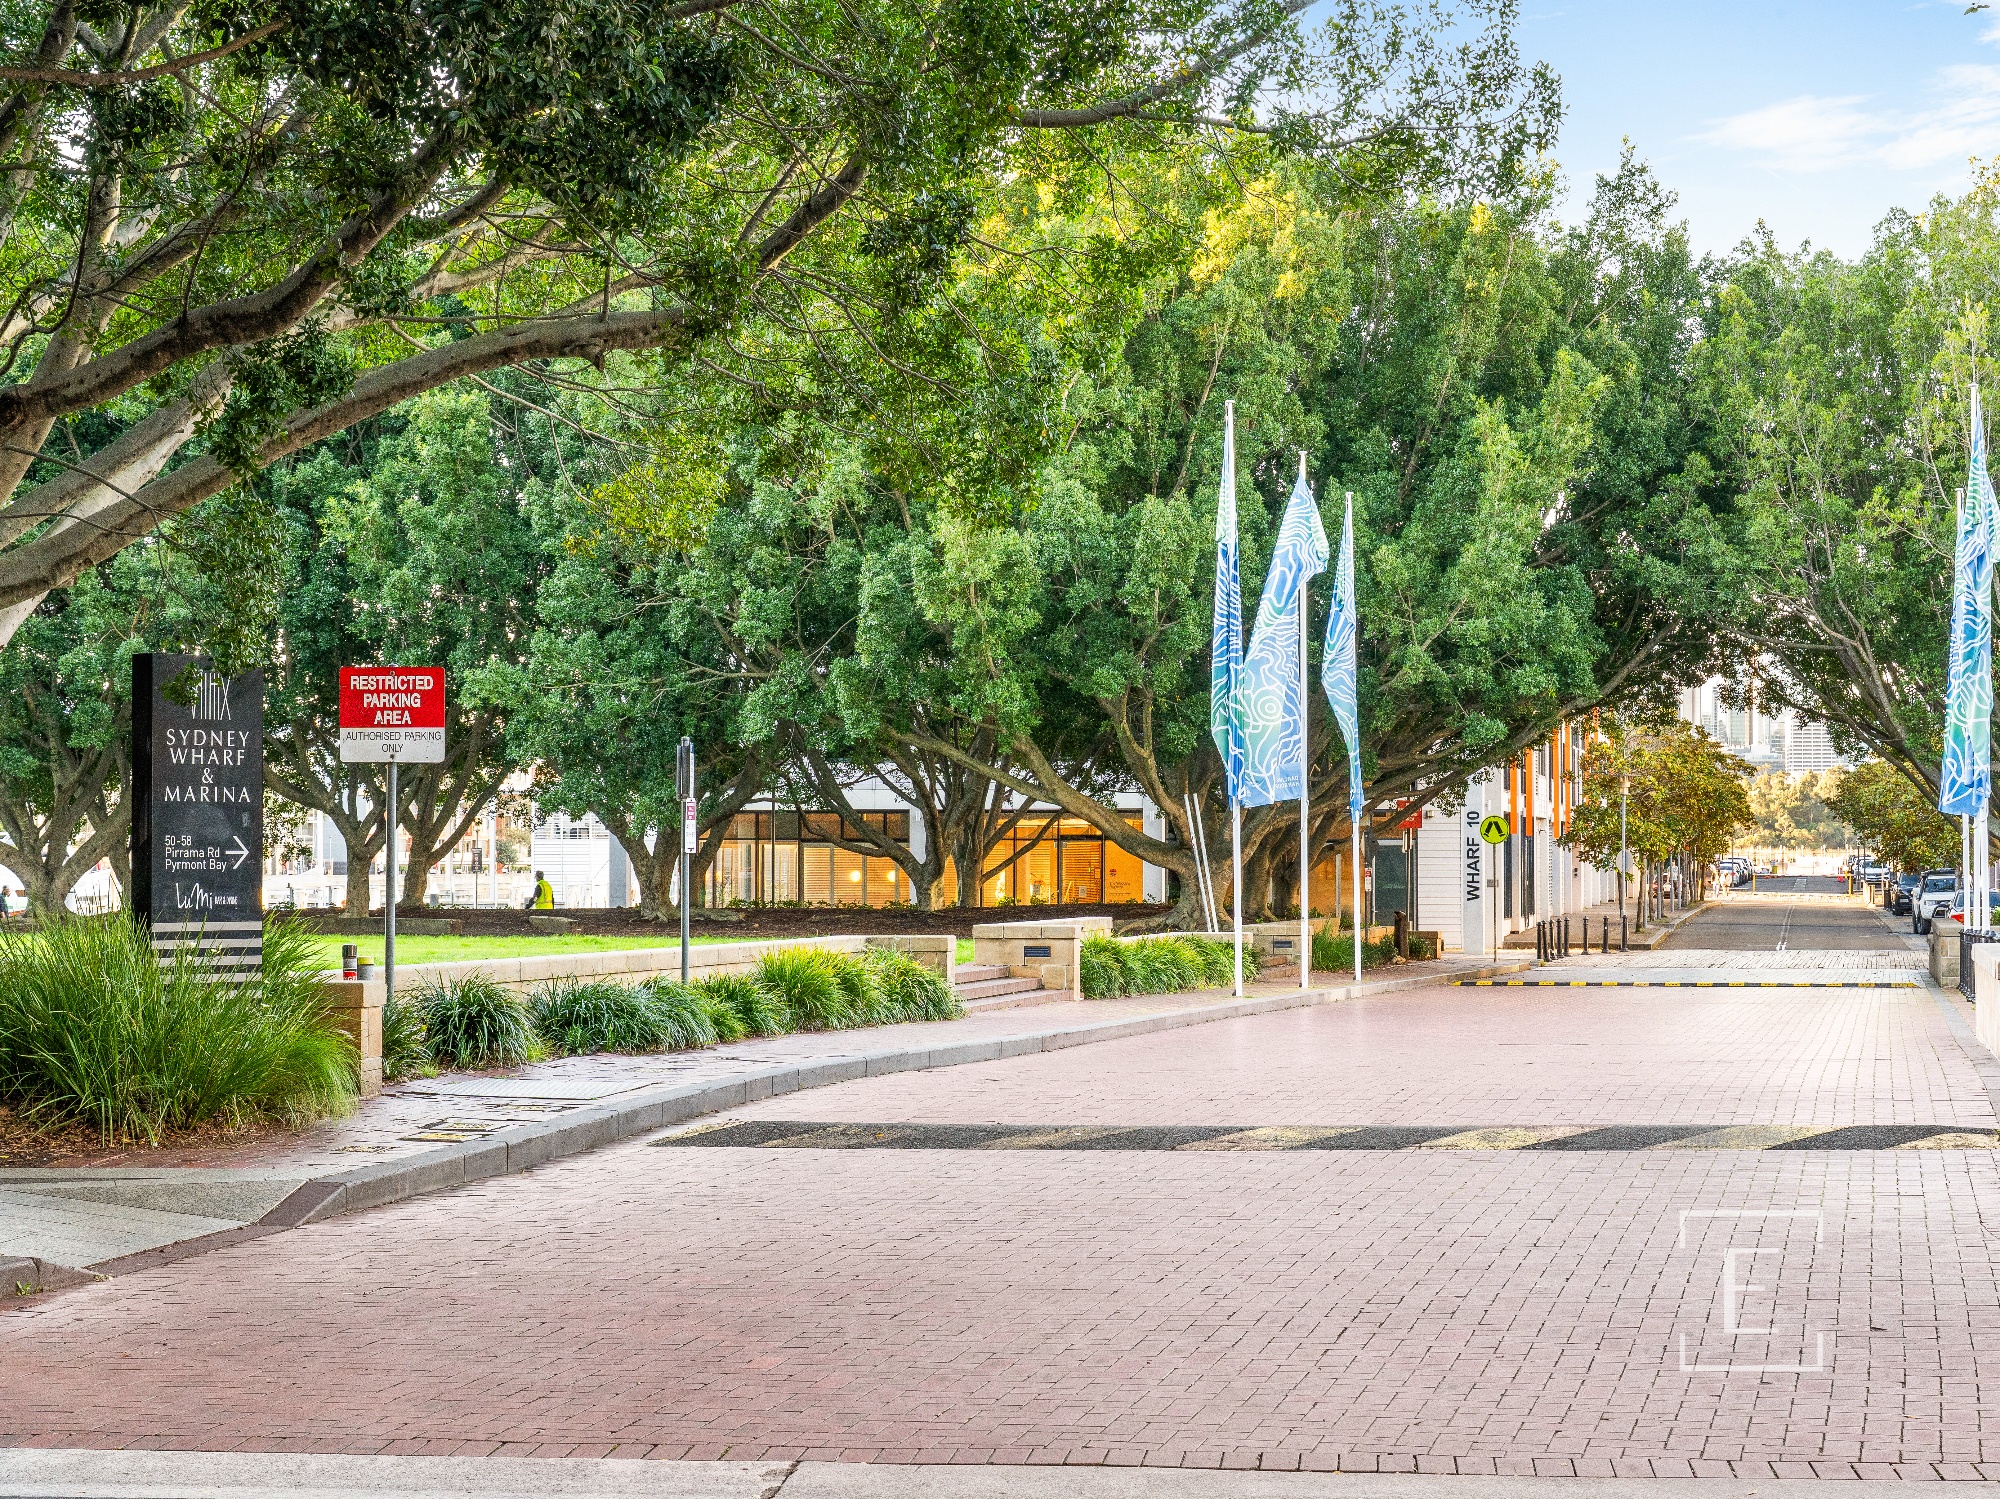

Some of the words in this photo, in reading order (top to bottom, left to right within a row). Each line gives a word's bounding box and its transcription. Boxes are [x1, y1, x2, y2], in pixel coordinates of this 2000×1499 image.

[350, 675, 434, 690] RESTRICTED
[363, 692, 421, 708] PARKING
[373, 710, 412, 725] AREA
[166, 728, 249, 747] SYDNEY
[345, 731, 401, 741] AUTHORISED
[404, 731, 442, 741] PARKING
[381, 743, 404, 753] ONLY
[169, 747, 245, 766] WHARF
[201, 767, 214, 784] &
[164, 785, 251, 803] MARINA
[1466, 810, 1480, 828] 10
[164, 835, 192, 846] 50-58
[165, 846, 205, 858] Pirrama
[207, 846, 220, 858] Rd
[165, 858, 206, 873] Pyrmont
[209, 858, 227, 873] Bay
[1466, 836, 1480, 902] WHARF
